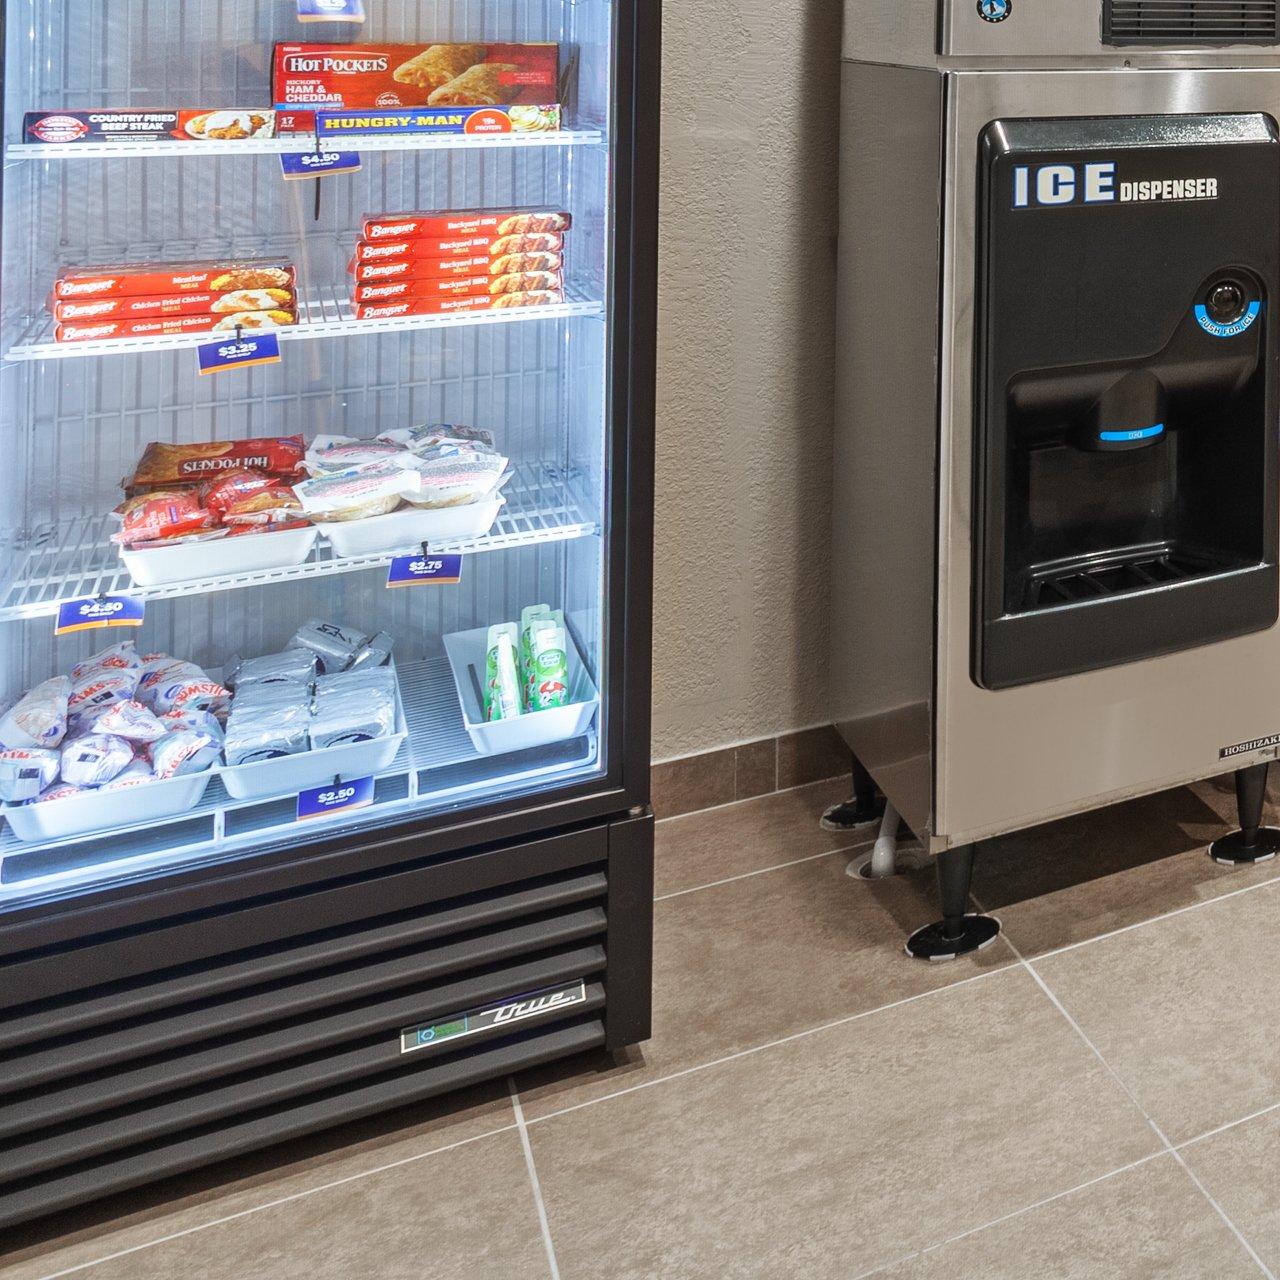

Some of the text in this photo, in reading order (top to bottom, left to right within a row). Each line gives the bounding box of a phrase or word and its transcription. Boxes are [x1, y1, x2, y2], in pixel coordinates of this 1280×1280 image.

[290, 57, 388, 73] HOT POCKETS
[286, 85, 326, 94] HAM &
[285, 94, 342, 104] CHEDDAR
[89, 114, 176, 124] COUNTRY FRIED
[325, 115, 463, 129] HUNGRY-MAN
[101, 122, 164, 131] BEEF STEAK
[301, 152, 340, 166] $4.50
[1013, 161, 1218, 208] ICE DISPENSER
[371, 223, 417, 238] Banquet
[363, 243, 408, 258] Banquet
[363, 263, 408, 277] Banquet
[61, 278, 116, 296] Banquet
[362, 284, 408, 298] Banquet
[62, 301, 118, 319] Banquet
[364, 304, 410, 319] Banquet
[63, 323, 118, 340] Banquet
[1200, 313, 1256, 336] PUSH FOR ICE
[218, 343, 257, 357] $3.25
[408, 560, 442, 572] $2.75
[317, 787, 355, 803] $2.50
